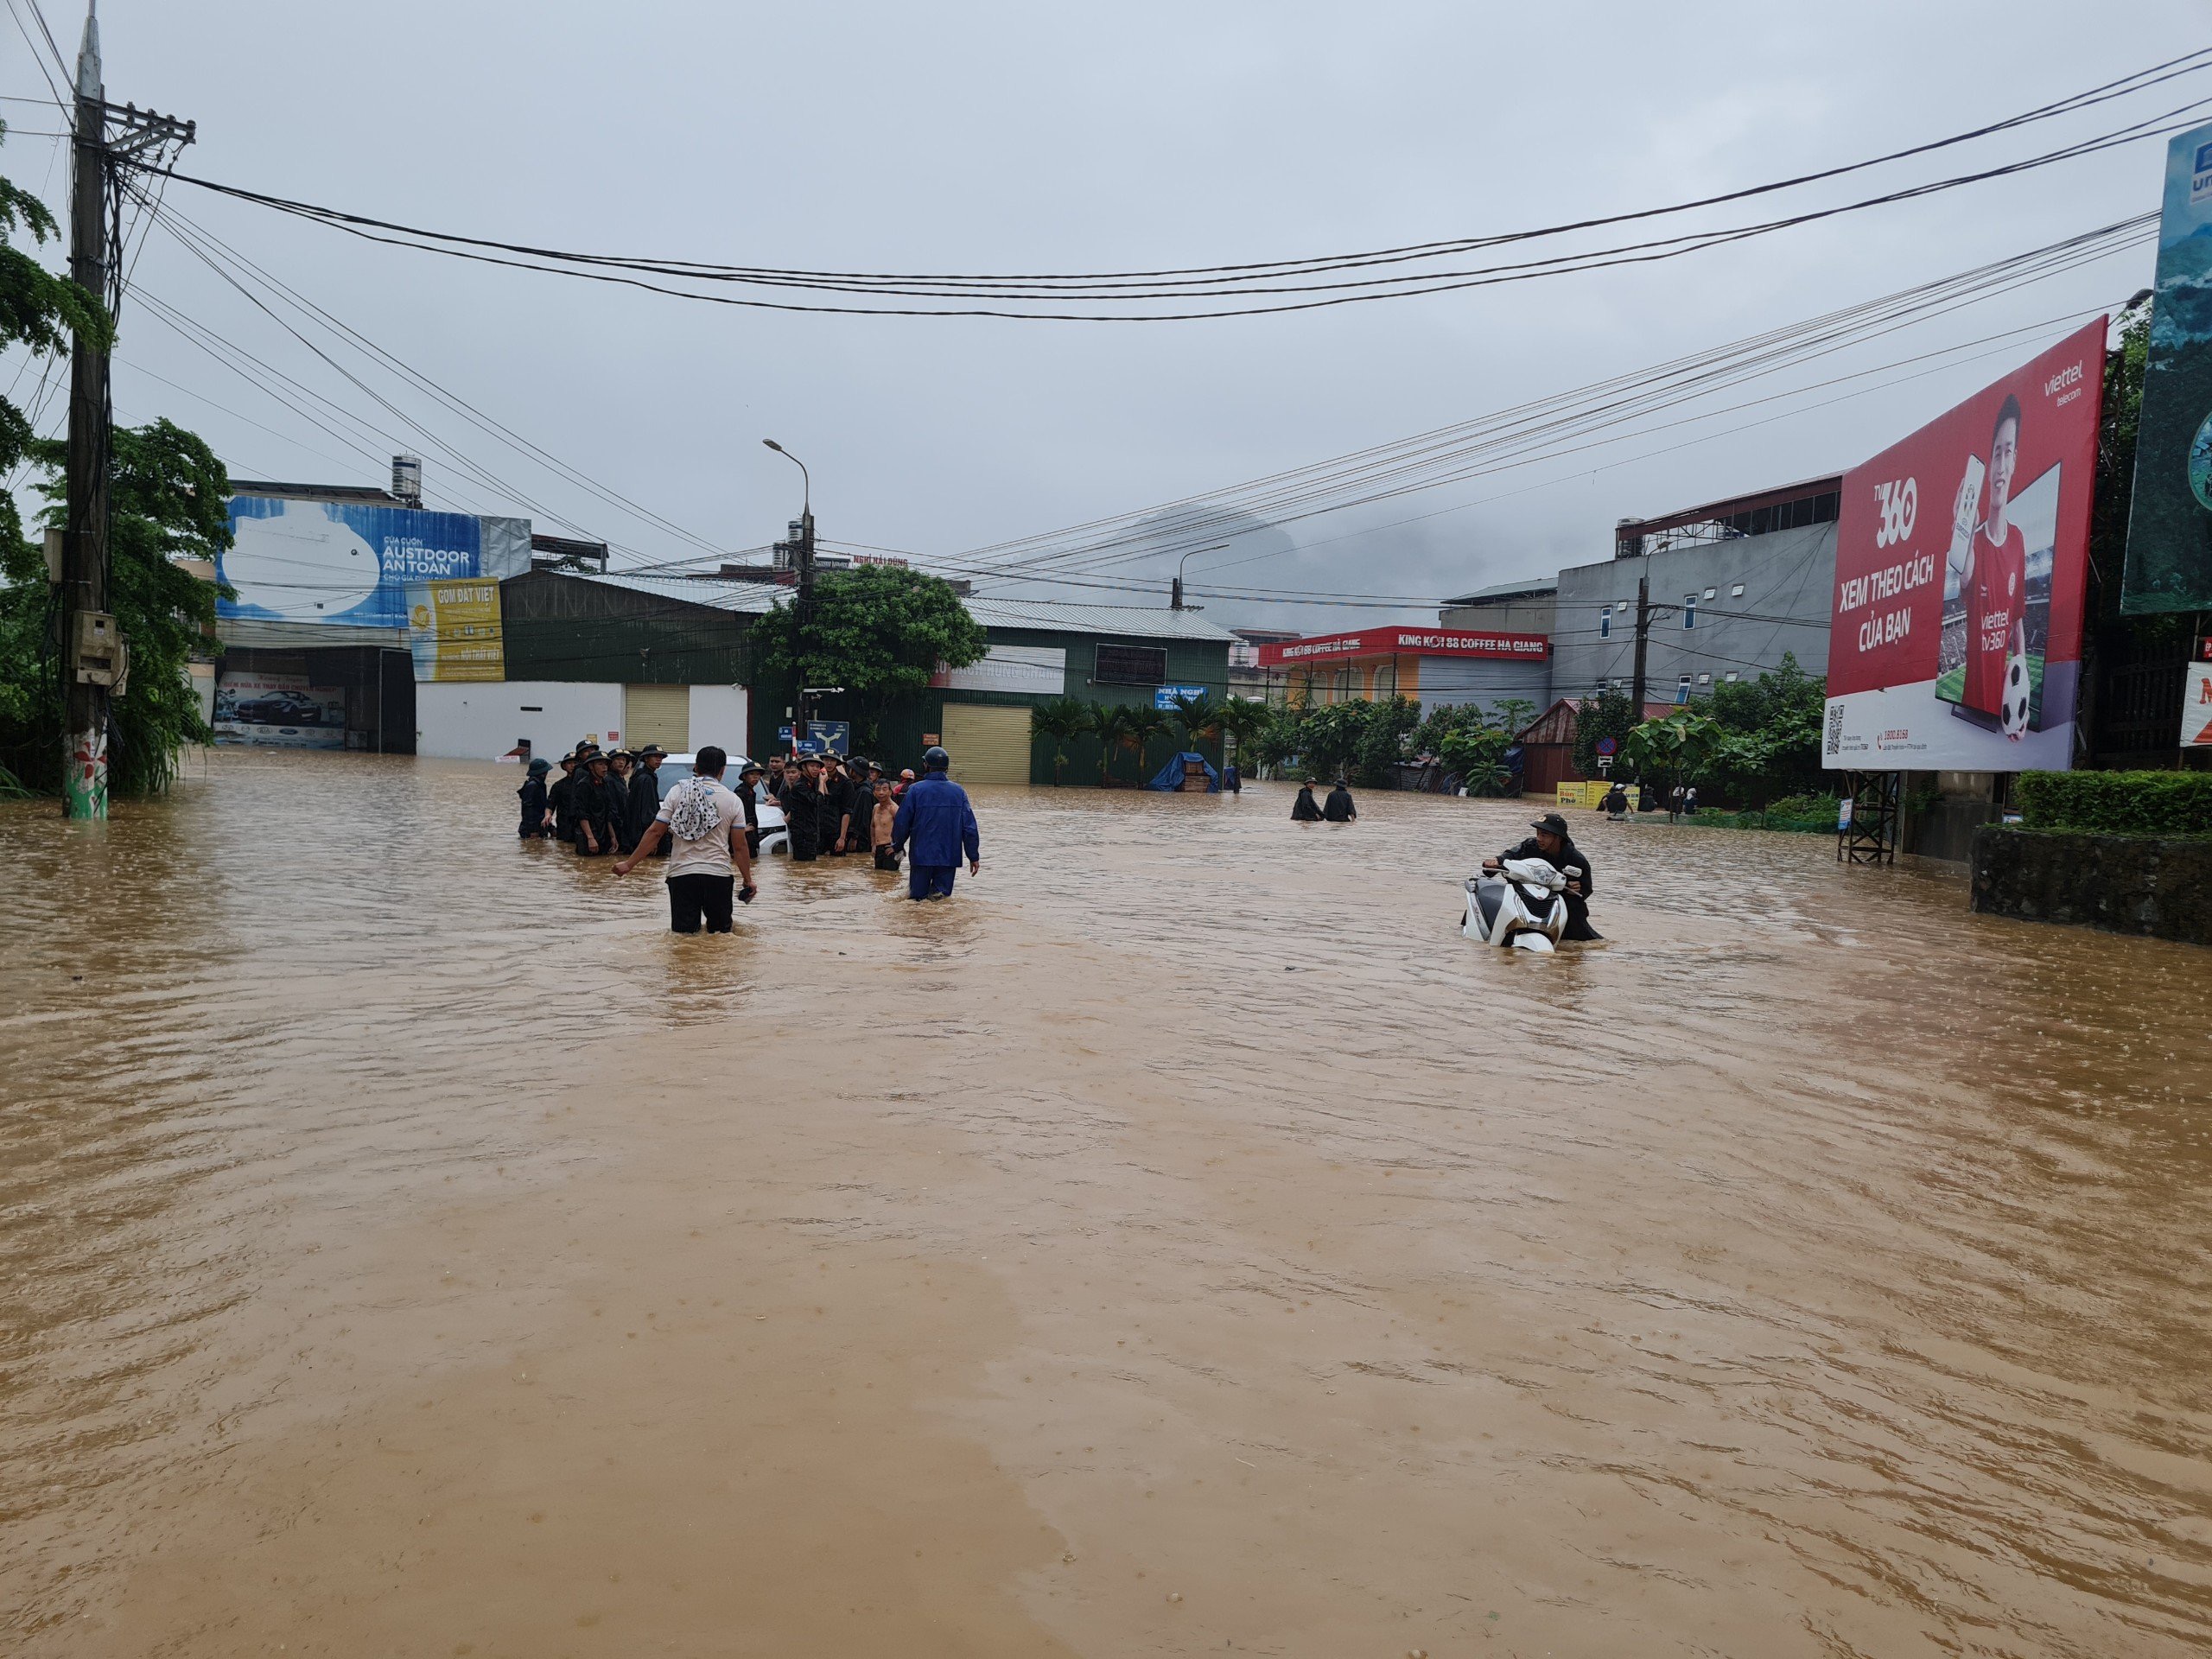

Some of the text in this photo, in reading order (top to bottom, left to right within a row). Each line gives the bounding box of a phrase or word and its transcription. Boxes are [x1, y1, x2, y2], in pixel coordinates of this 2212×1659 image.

[2044, 359, 2082, 397] viettel
[2057, 388, 2082, 407] telecom
[383, 545, 470, 564] AUSTDOOR
[383, 559, 451, 575] AN TOÀN
[1839, 549, 1935, 613] XEM THEO CÁCH
[1859, 607, 1911, 652] CỦA BẠN
[1980, 607, 2010, 630] viettel
[1398, 633, 1422, 645] KING
[1446, 637, 1459, 648] 88
[1460, 638, 1496, 651] COFFEE
[1497, 639, 1511, 652] HÀ
[1513, 640, 1543, 652] GIANG
[1981, 630, 2005, 652] tv360
